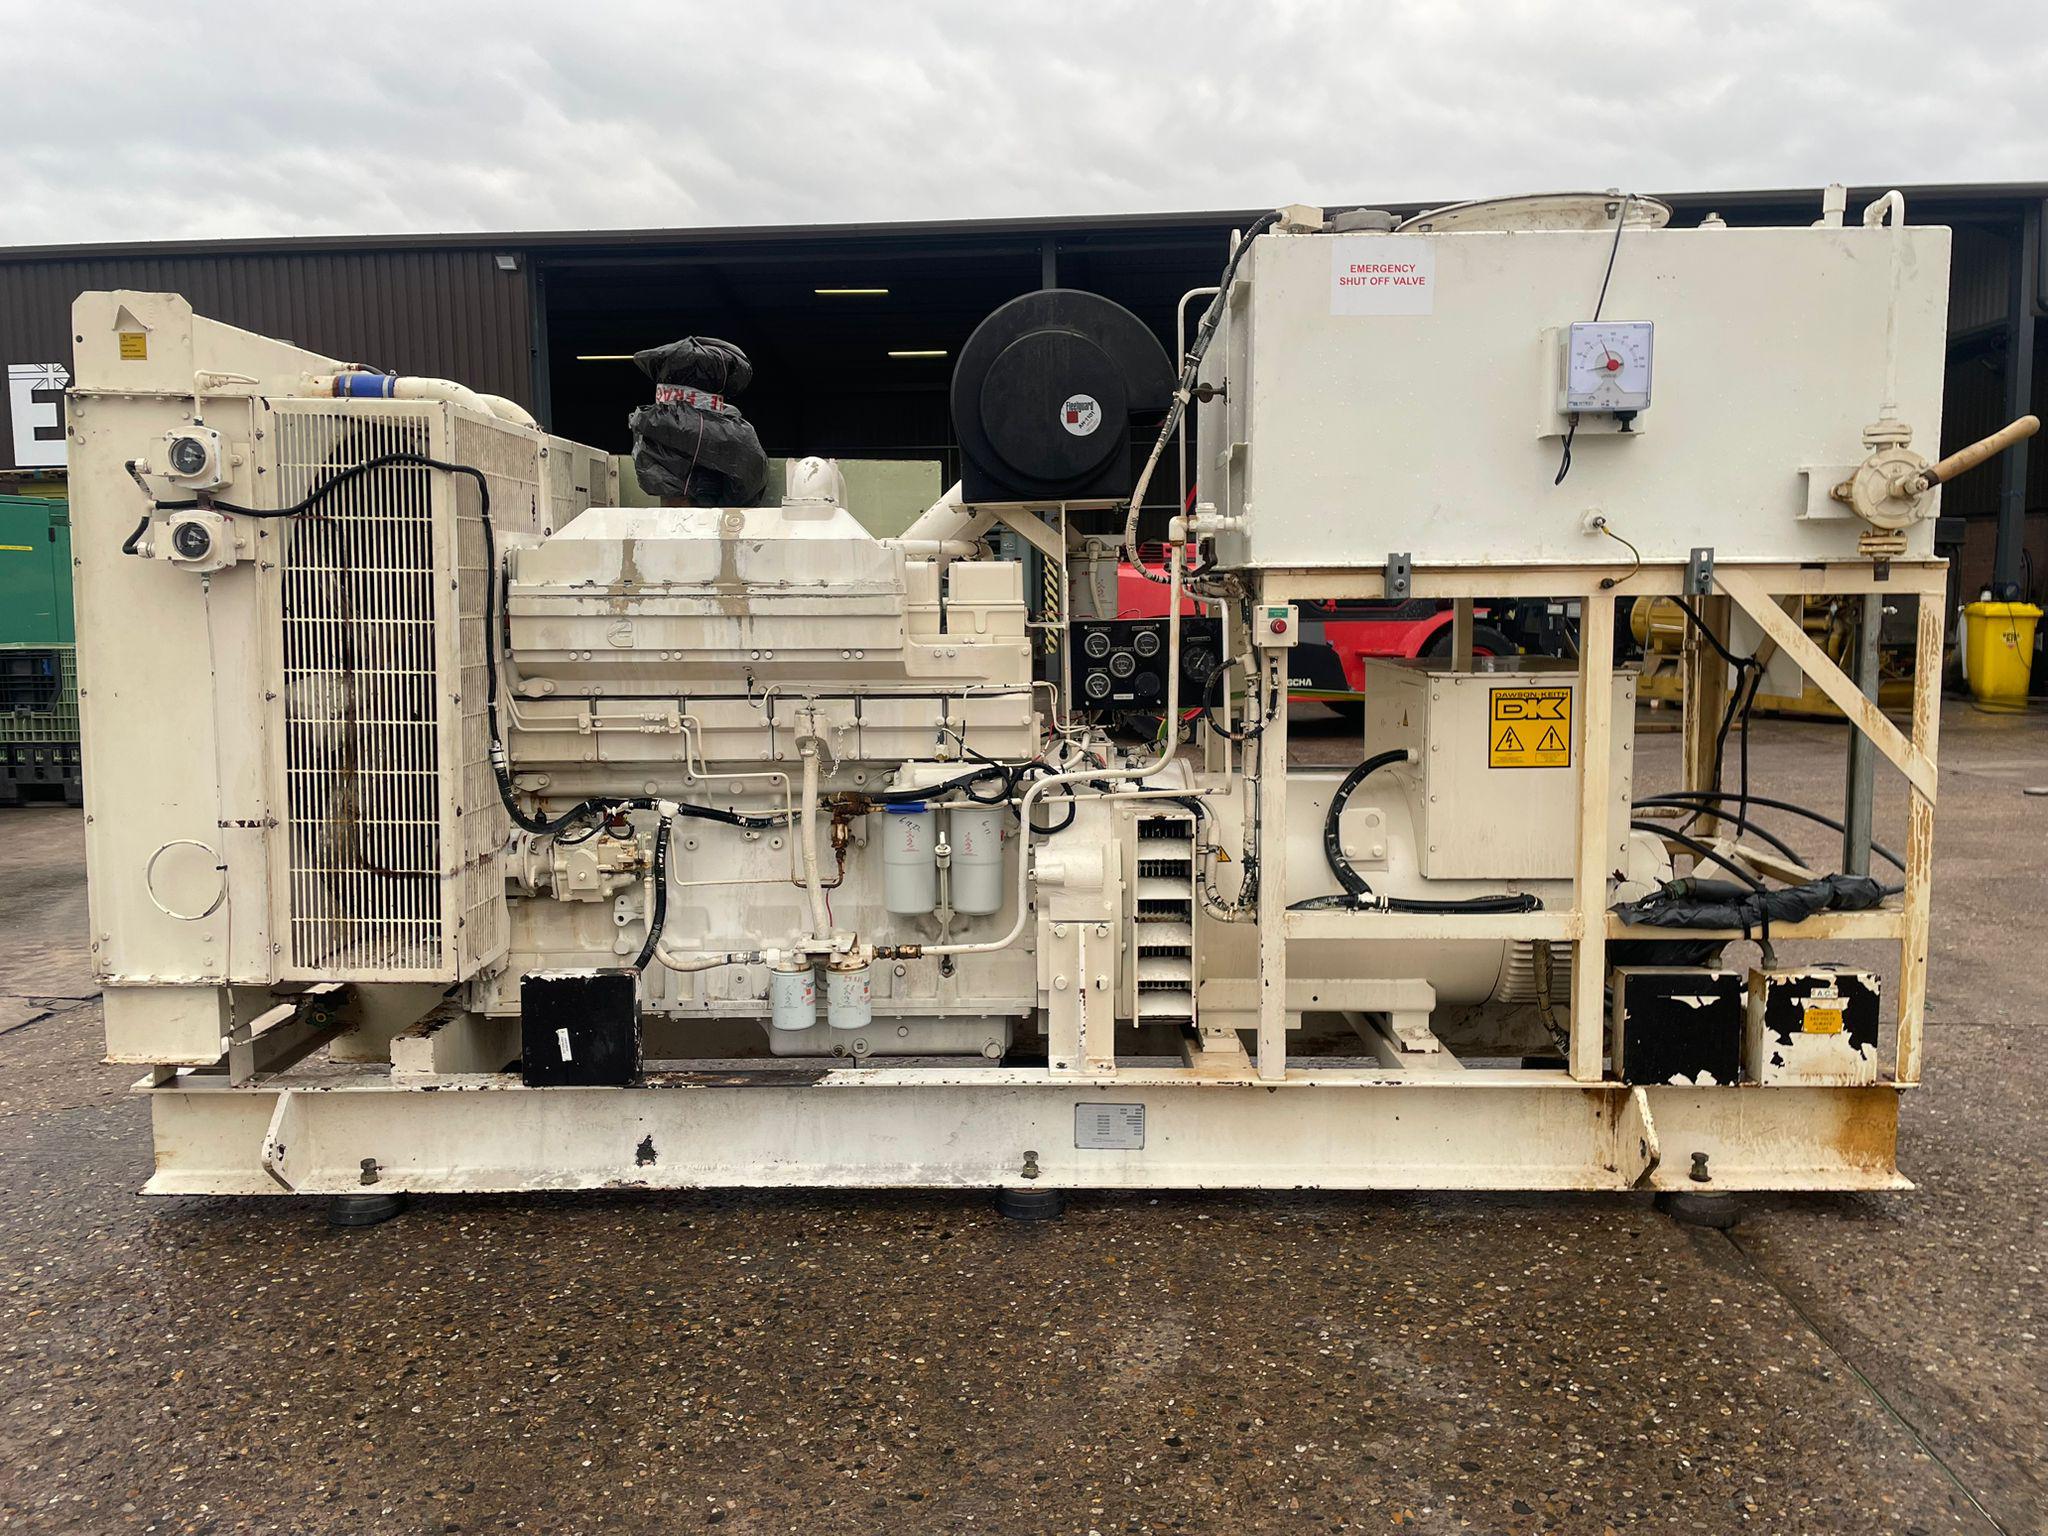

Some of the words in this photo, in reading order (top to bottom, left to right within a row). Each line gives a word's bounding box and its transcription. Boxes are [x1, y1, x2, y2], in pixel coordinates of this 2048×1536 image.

[1350, 264, 1416, 273] EMERGENCY
[1339, 277, 1367, 286] SHUT
[1370, 277, 1390, 286] OFF
[1393, 277, 1426, 286] VALVE
[1495, 697, 1567, 721] DK
